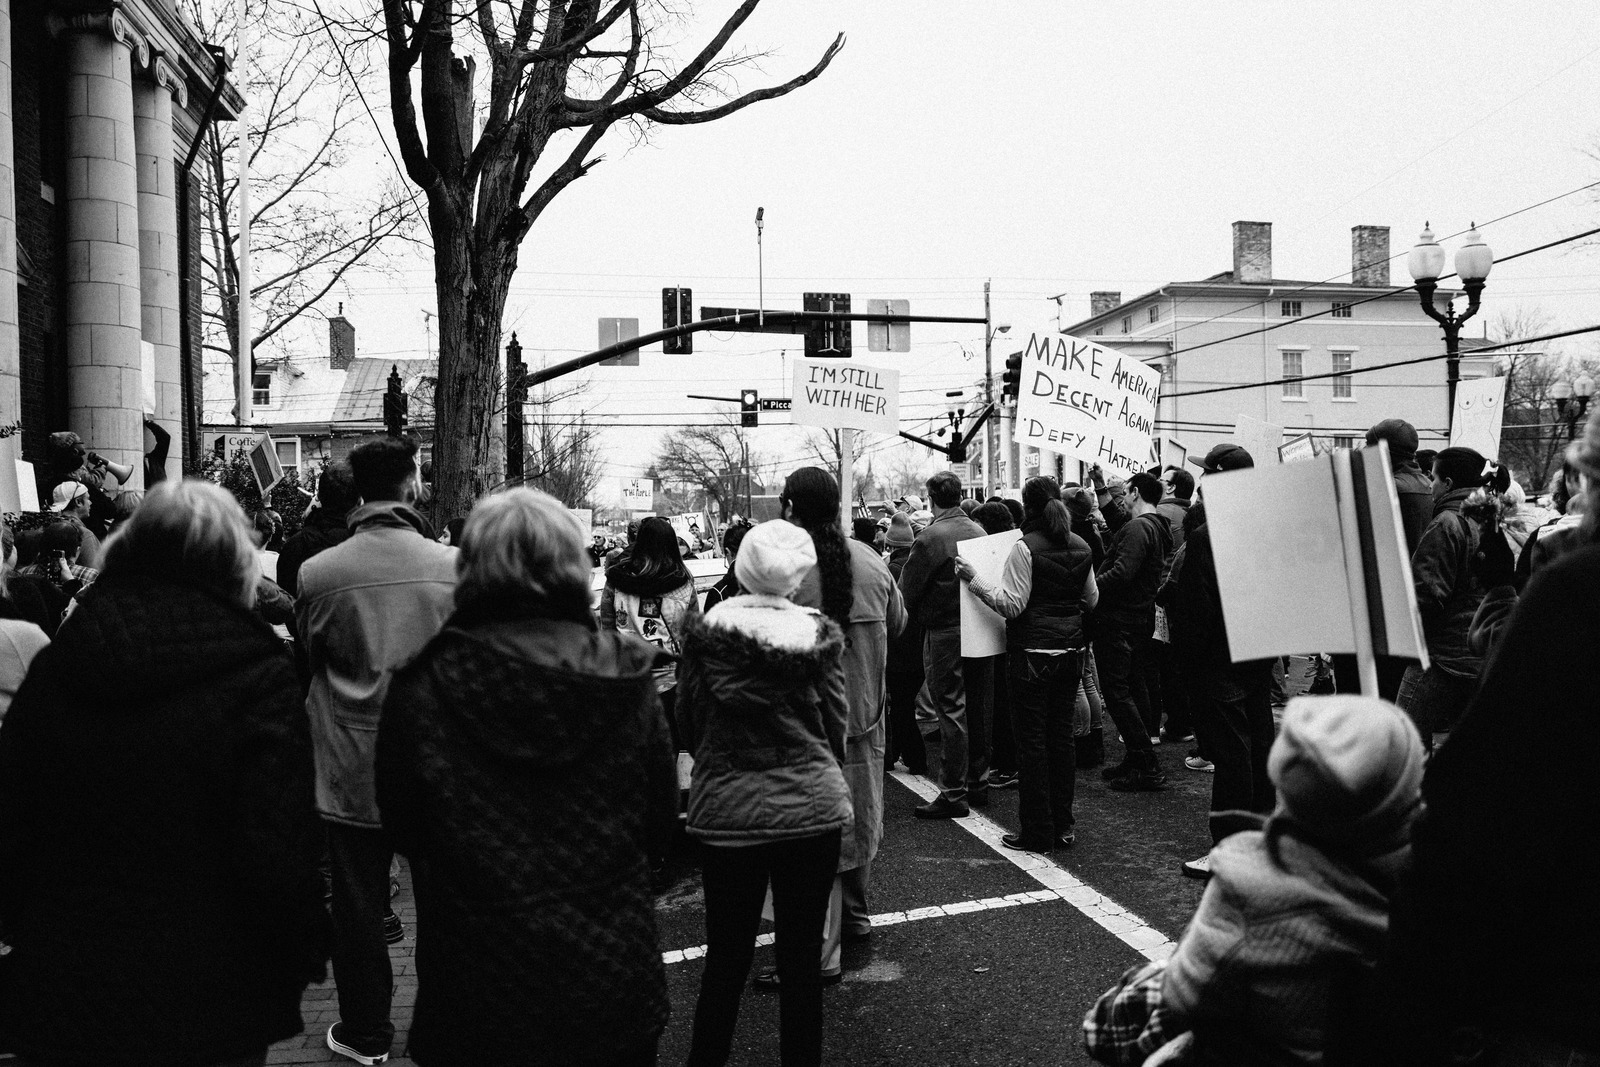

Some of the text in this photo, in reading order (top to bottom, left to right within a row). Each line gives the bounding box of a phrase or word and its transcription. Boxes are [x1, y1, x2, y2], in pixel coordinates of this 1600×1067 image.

[808, 366, 884, 390] I'M STILL
[1025, 332, 1158, 408] MAKE AMERICA
[805, 385, 887, 416] WITH HER
[1032, 370, 1153, 436] DECENT AGAIN
[229, 436, 258, 446] Coffe
[1024, 454, 1038, 467] SALE
